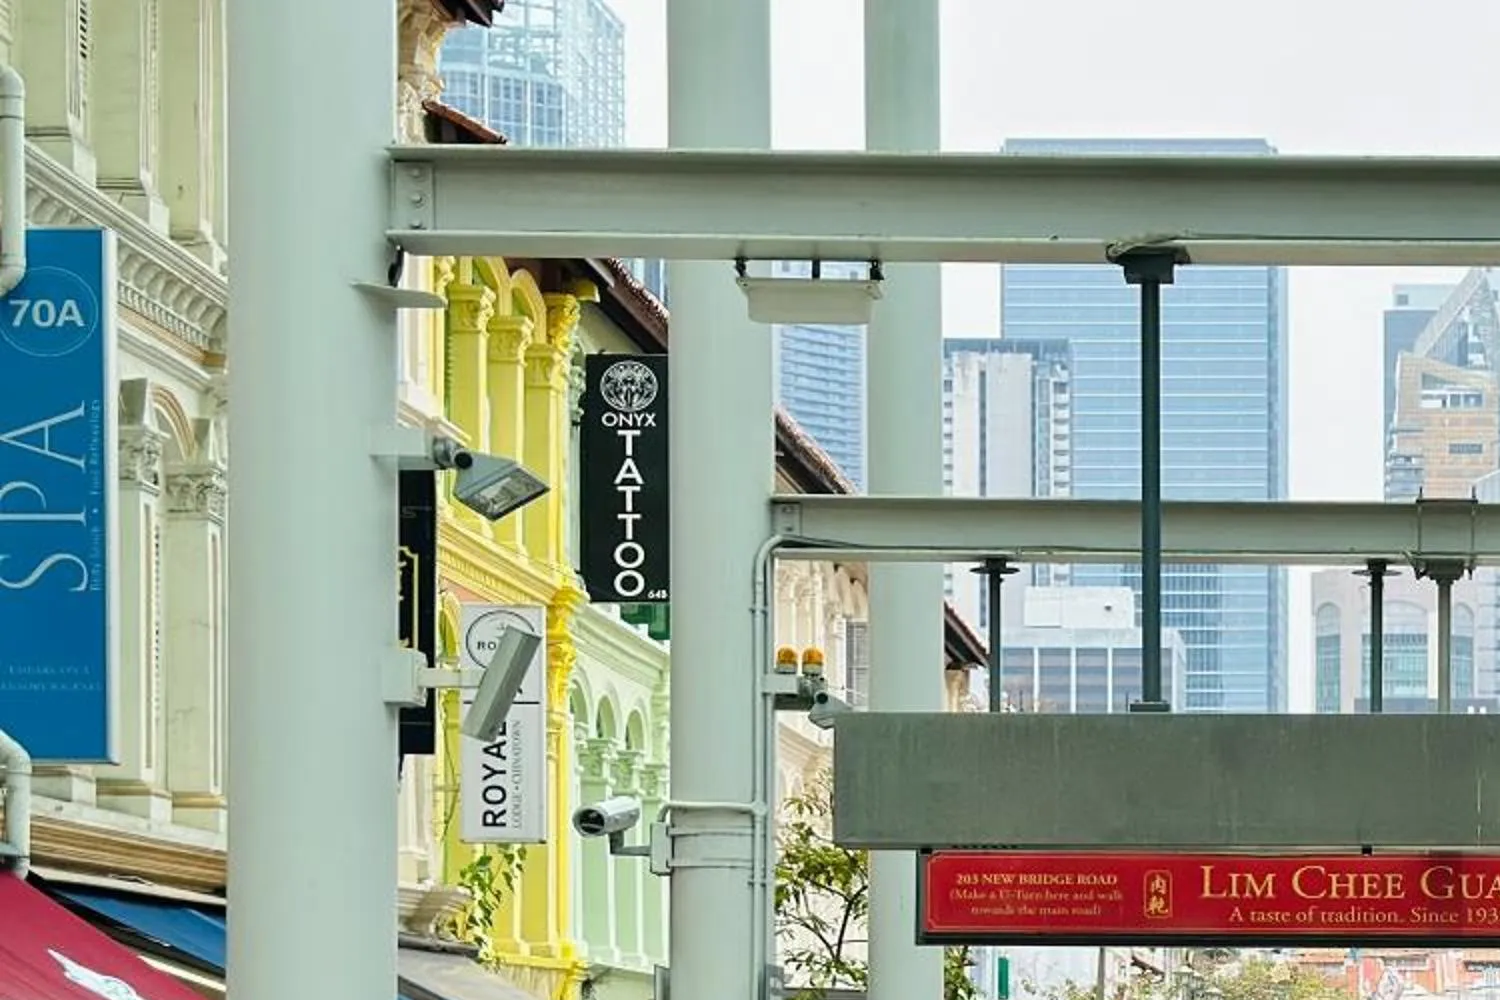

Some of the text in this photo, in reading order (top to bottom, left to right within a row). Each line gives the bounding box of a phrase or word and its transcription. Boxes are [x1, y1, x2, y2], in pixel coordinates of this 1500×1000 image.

[9, 299, 84, 327] 70A
[602, 413, 655, 427] ONYX
[0, 399, 88, 592] SPA
[614, 429, 645, 597] TATTOO
[957, 874, 1118, 885] 203 NEW BRIDGE ROAD
[1201, 865, 1276, 899] LIM
[1292, 865, 1405, 899] CHEE
[1039, 906, 1069, 915] main
[1229, 906, 1244, 922] A
[1250, 909, 1291, 922] taste
[1295, 906, 1319, 922] of
[1321, 906, 1406, 922] tradition.
[1411, 907, 1459, 923] Since
